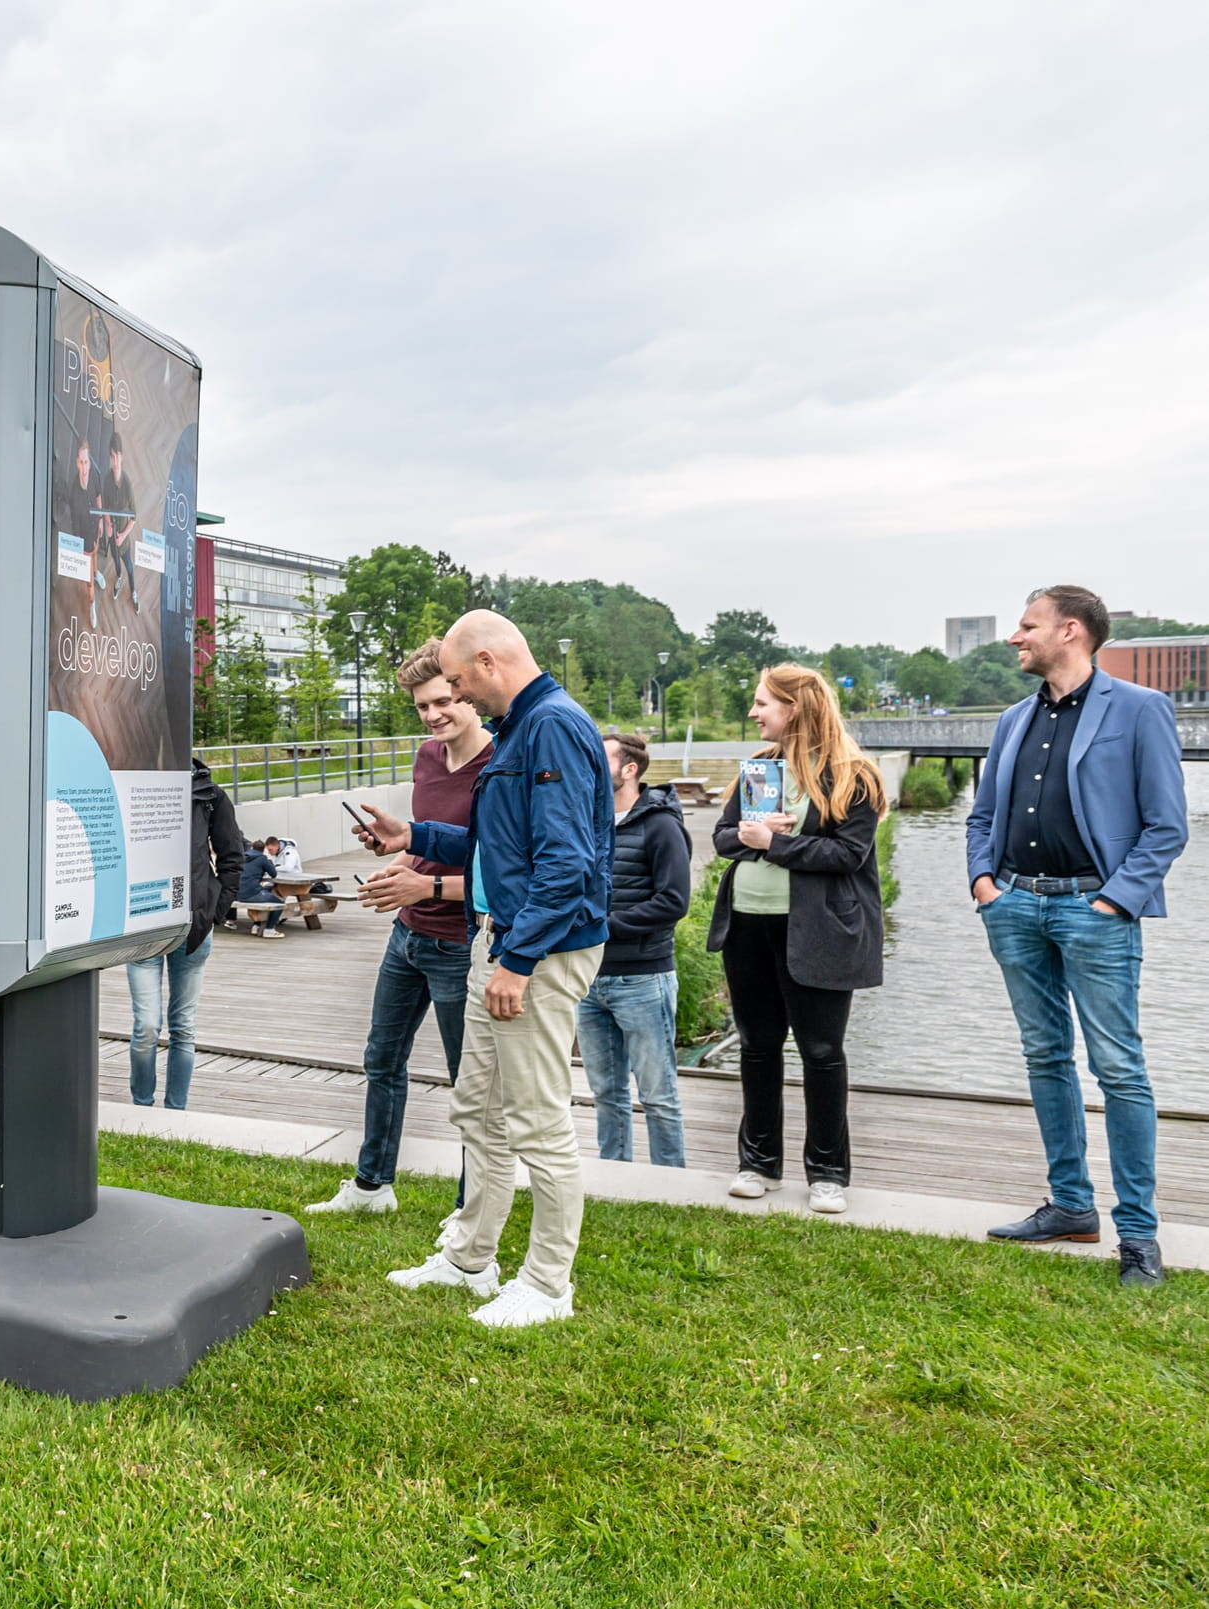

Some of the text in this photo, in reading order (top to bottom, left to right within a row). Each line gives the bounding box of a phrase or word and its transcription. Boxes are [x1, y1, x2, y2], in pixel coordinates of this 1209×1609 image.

[63, 337, 131, 421] Place
[167, 480, 189, 531] to
[185, 531, 196, 610] Factory
[58, 615, 158, 691] develop
[740, 761, 767, 775] Place
[763, 784, 778, 799] to
